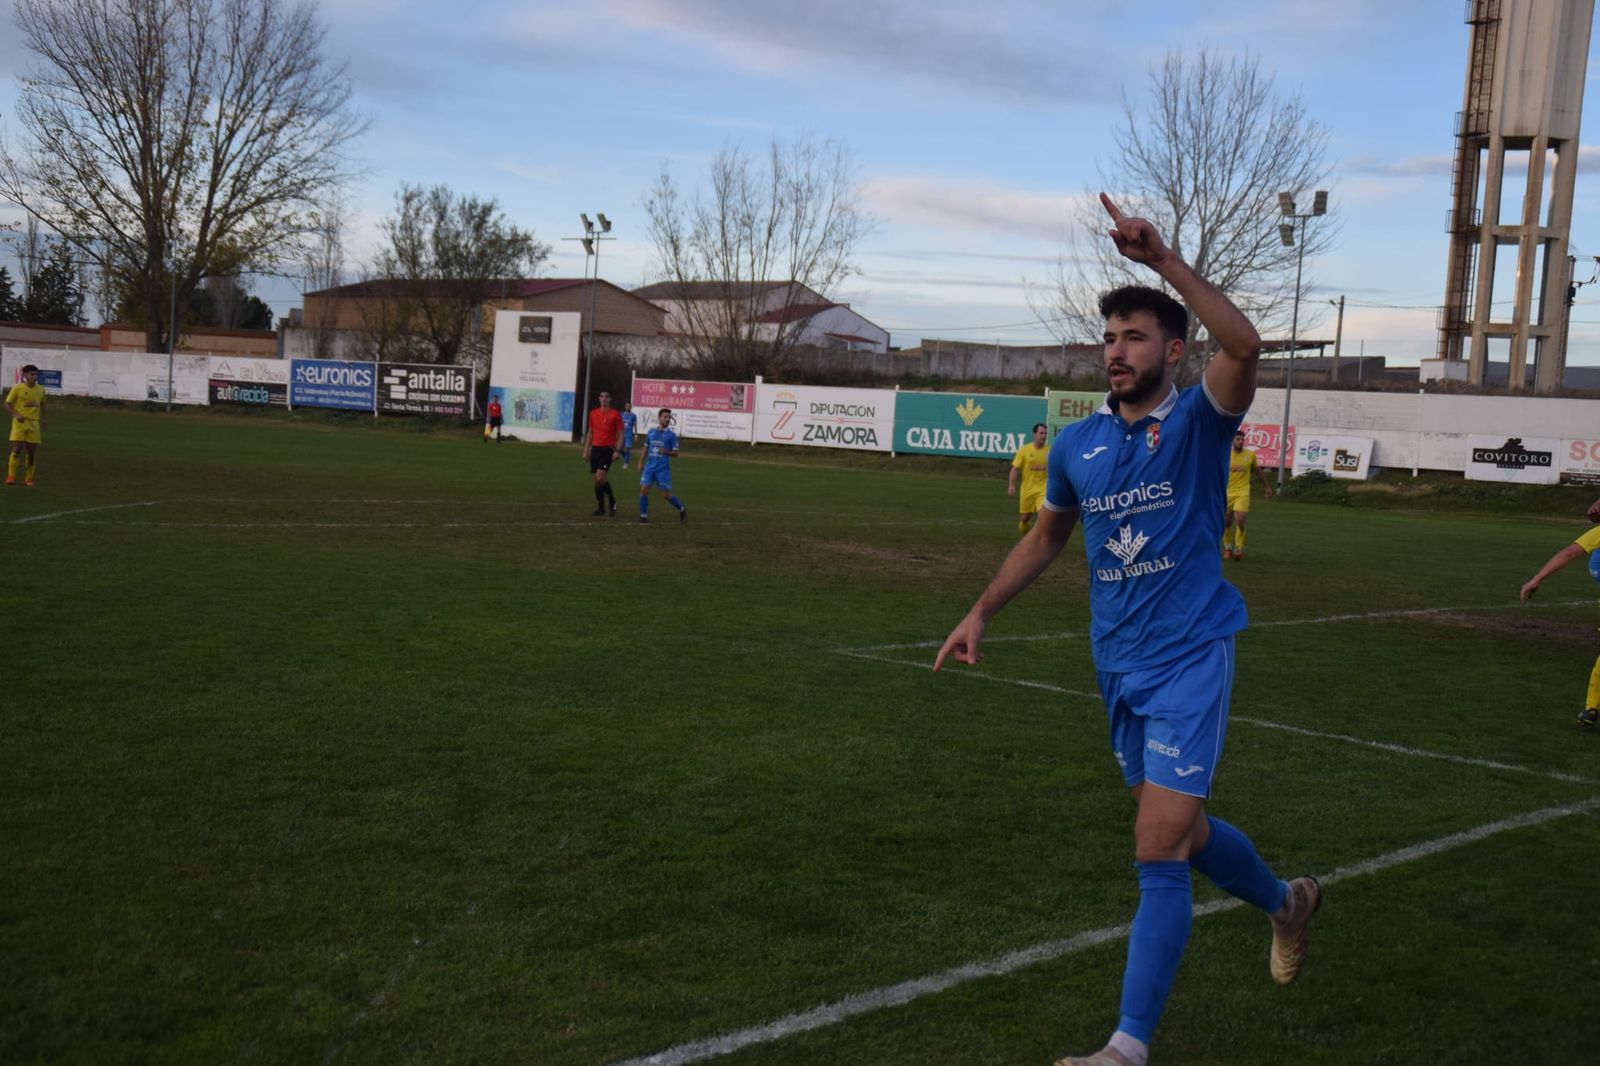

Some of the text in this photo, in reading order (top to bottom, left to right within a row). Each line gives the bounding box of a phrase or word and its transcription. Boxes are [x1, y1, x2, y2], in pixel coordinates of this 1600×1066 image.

[305, 366, 371, 387] euronics
[408, 370, 465, 392] antalia
[641, 394, 696, 408] RESTAURANTE
[803, 424, 879, 446] ZAMORA
[906, 427, 954, 450] CAJA
[1475, 451, 1549, 464] COVITORO
[1089, 481, 1174, 512] euronics
[1125, 556, 1175, 578] RURAL
